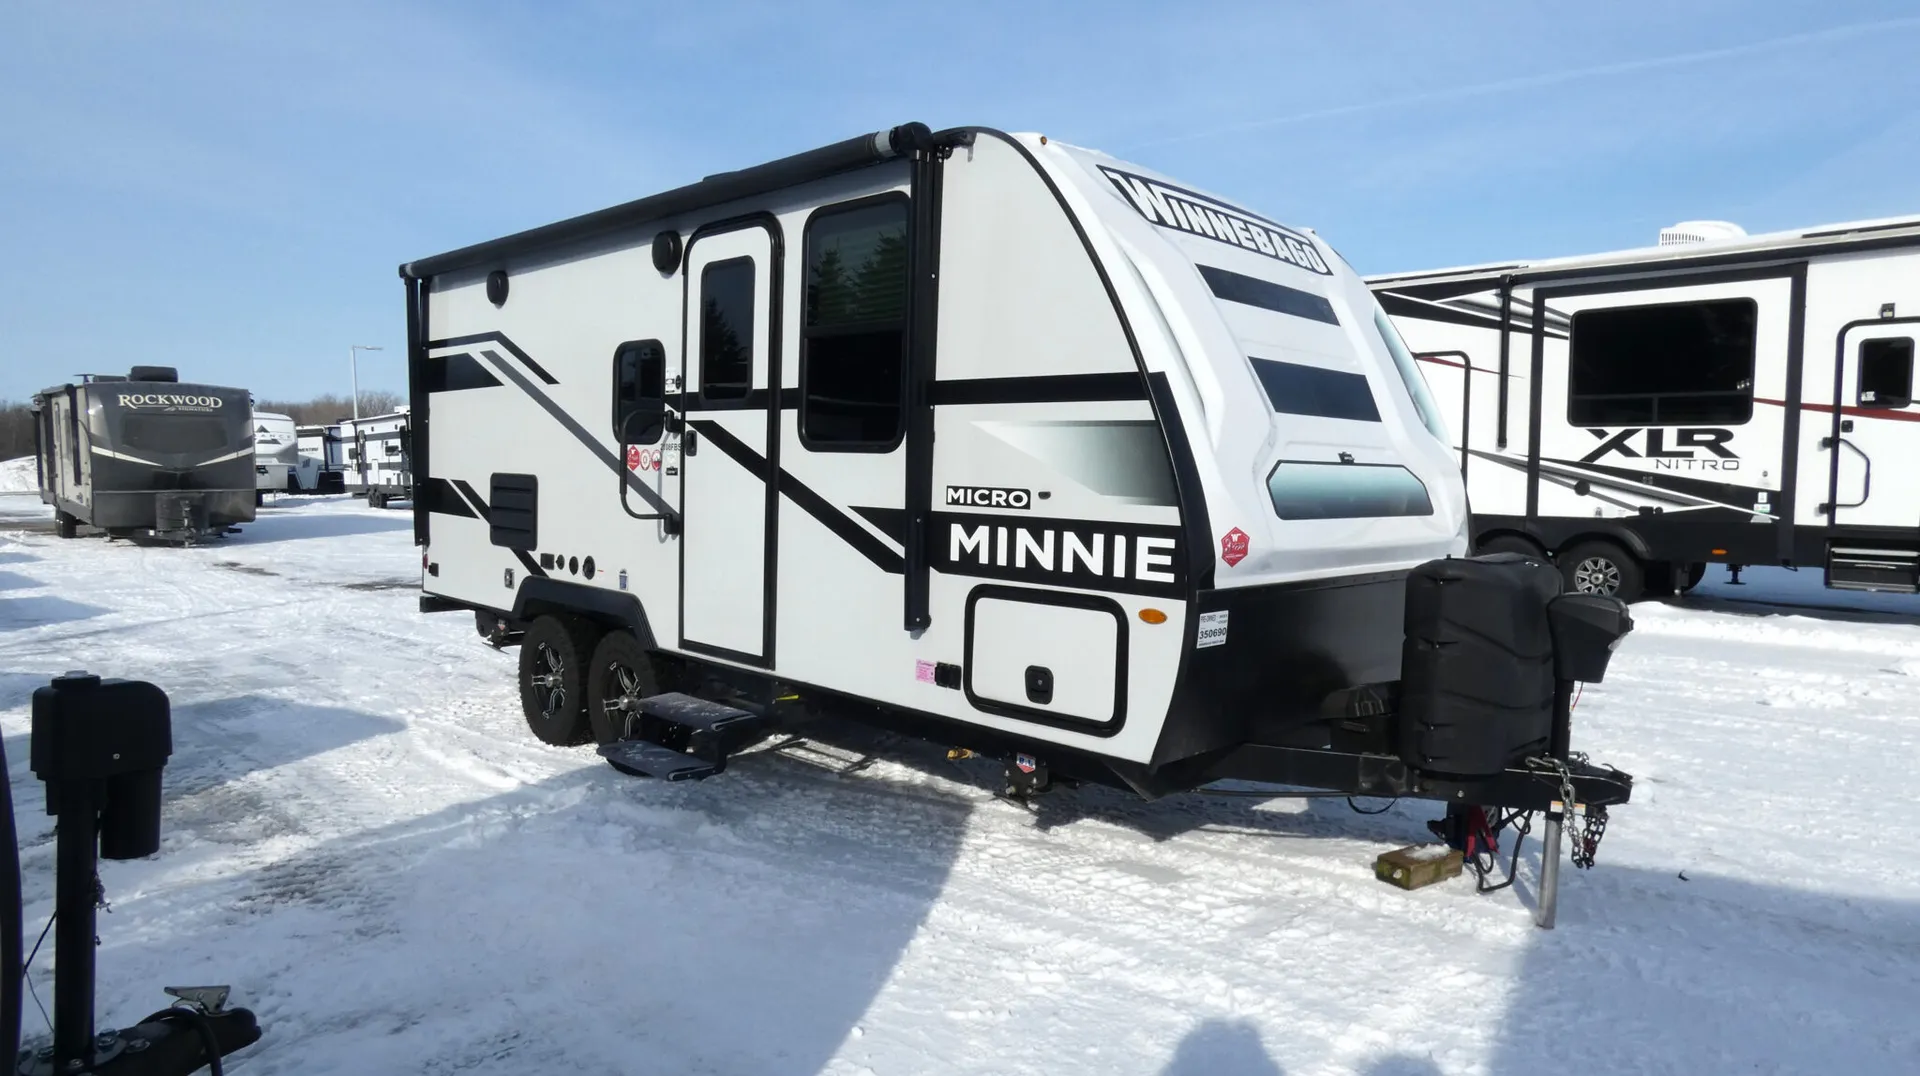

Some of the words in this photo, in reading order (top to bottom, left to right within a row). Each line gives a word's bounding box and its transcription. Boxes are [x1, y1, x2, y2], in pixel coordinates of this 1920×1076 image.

[1103, 170, 1327, 274] WINNEBAGO
[118, 394, 222, 409] ROCKWOOD
[1579, 428, 1741, 463] XLR
[1656, 459, 1740, 470] NITRO
[947, 488, 1028, 507] MICRO
[950, 523, 1176, 583] MINNIE
[1199, 627, 1227, 639] 350690
